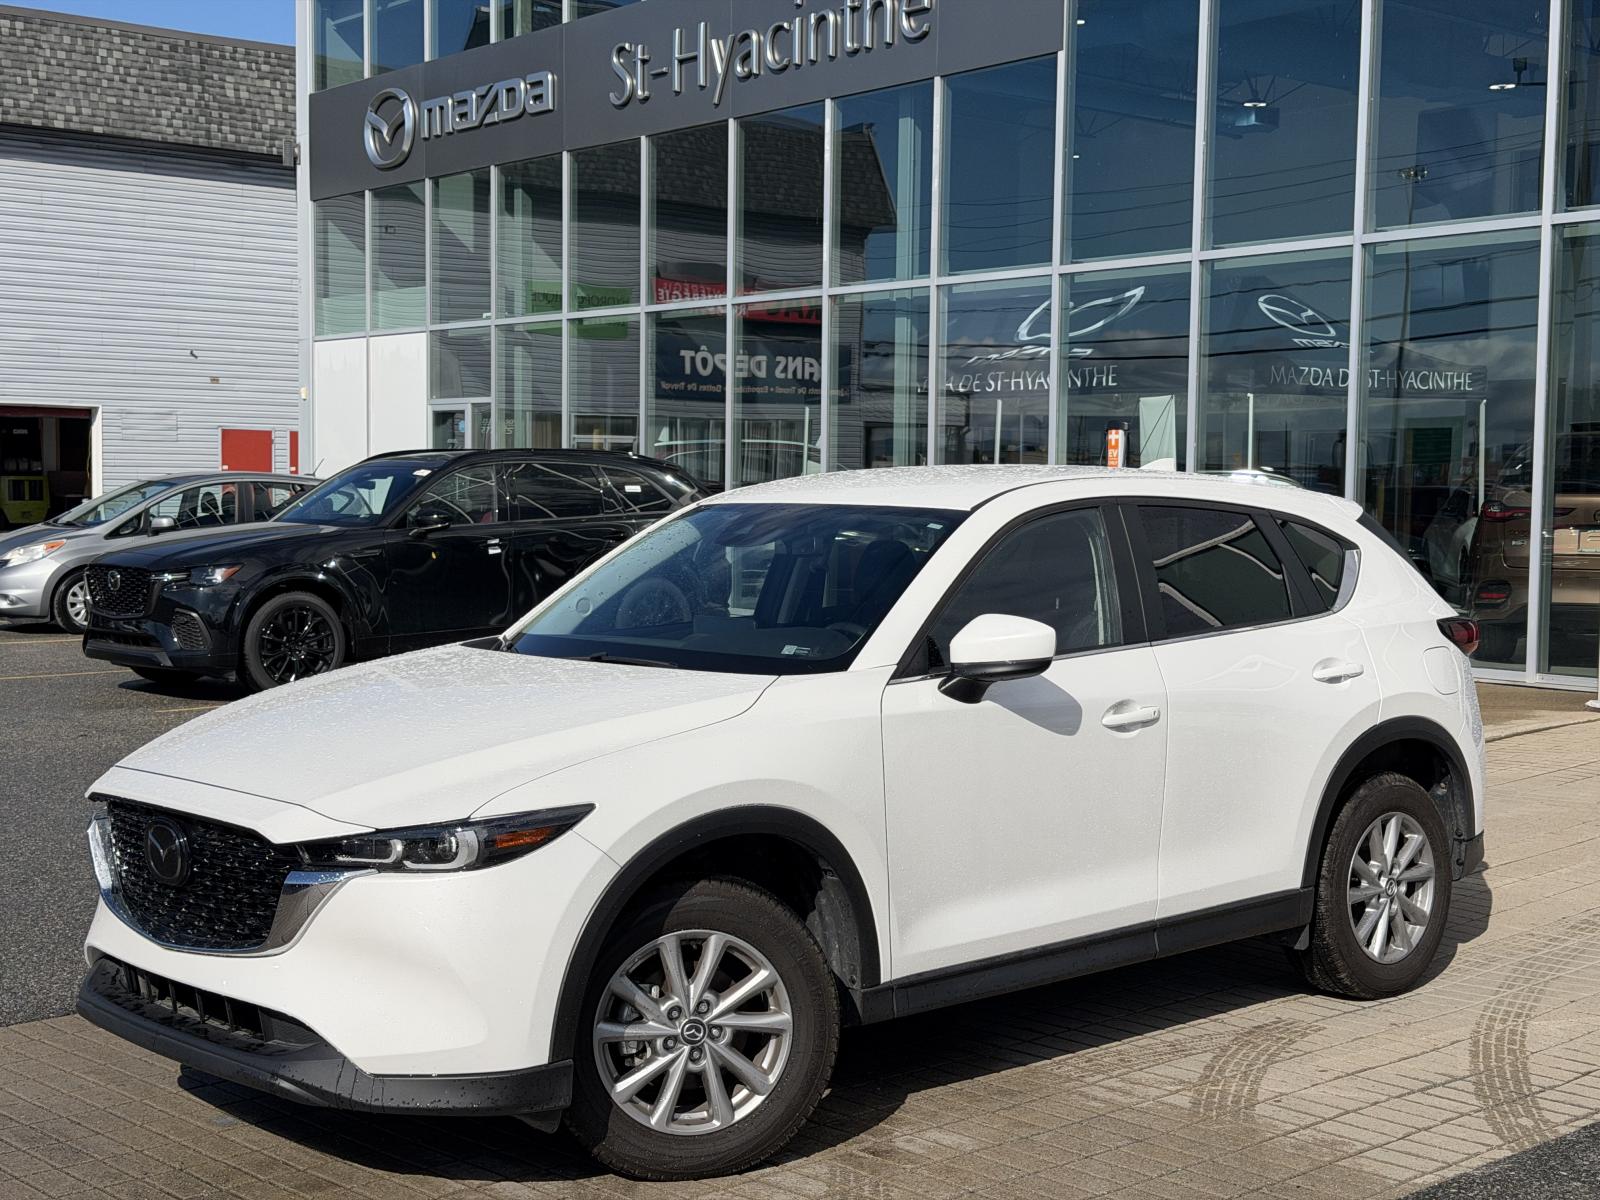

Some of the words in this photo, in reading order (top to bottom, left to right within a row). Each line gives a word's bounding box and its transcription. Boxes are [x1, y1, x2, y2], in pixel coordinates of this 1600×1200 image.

[609, 0, 932, 109] St-Hyacinthe
[420, 70, 556, 139] mazda
[985, 364, 1119, 393] ST-HYANTHE
[1269, 364, 1334, 387] MAZDA
[1339, 368, 1350, 388] D
[1367, 368, 1473, 391] ST-HYACINTHE
